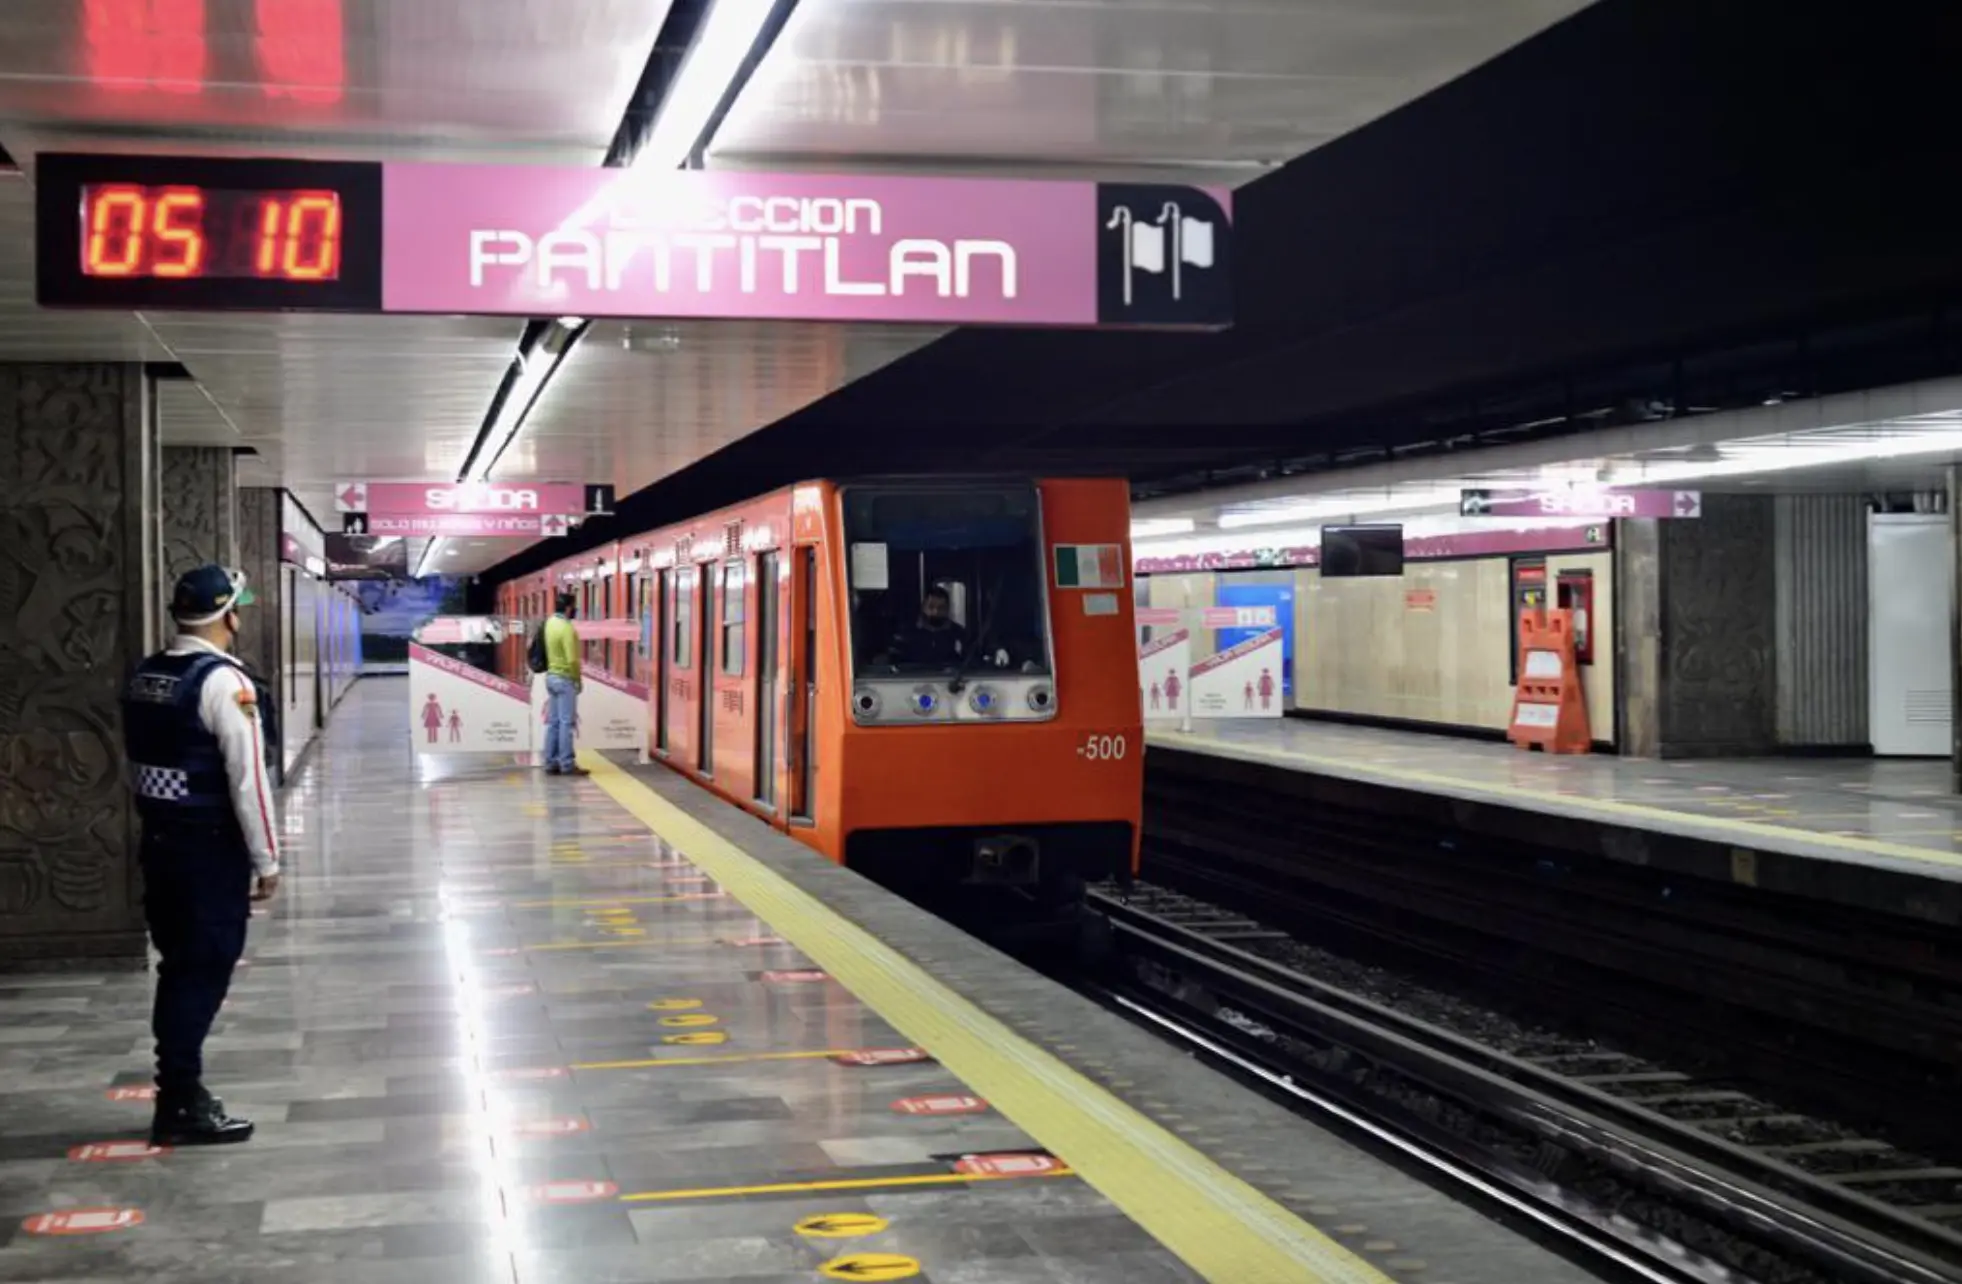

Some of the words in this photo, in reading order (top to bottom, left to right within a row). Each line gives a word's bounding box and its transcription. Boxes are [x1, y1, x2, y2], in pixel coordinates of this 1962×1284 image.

[88, 189, 202, 277] 05
[258, 193, 340, 280] 10
[610, 195, 883, 235] DECCION
[469, 229, 1017, 299] PANTITLAN
[424, 488, 538, 512] SIDA
[1540, 493, 1636, 514] SAIDA
